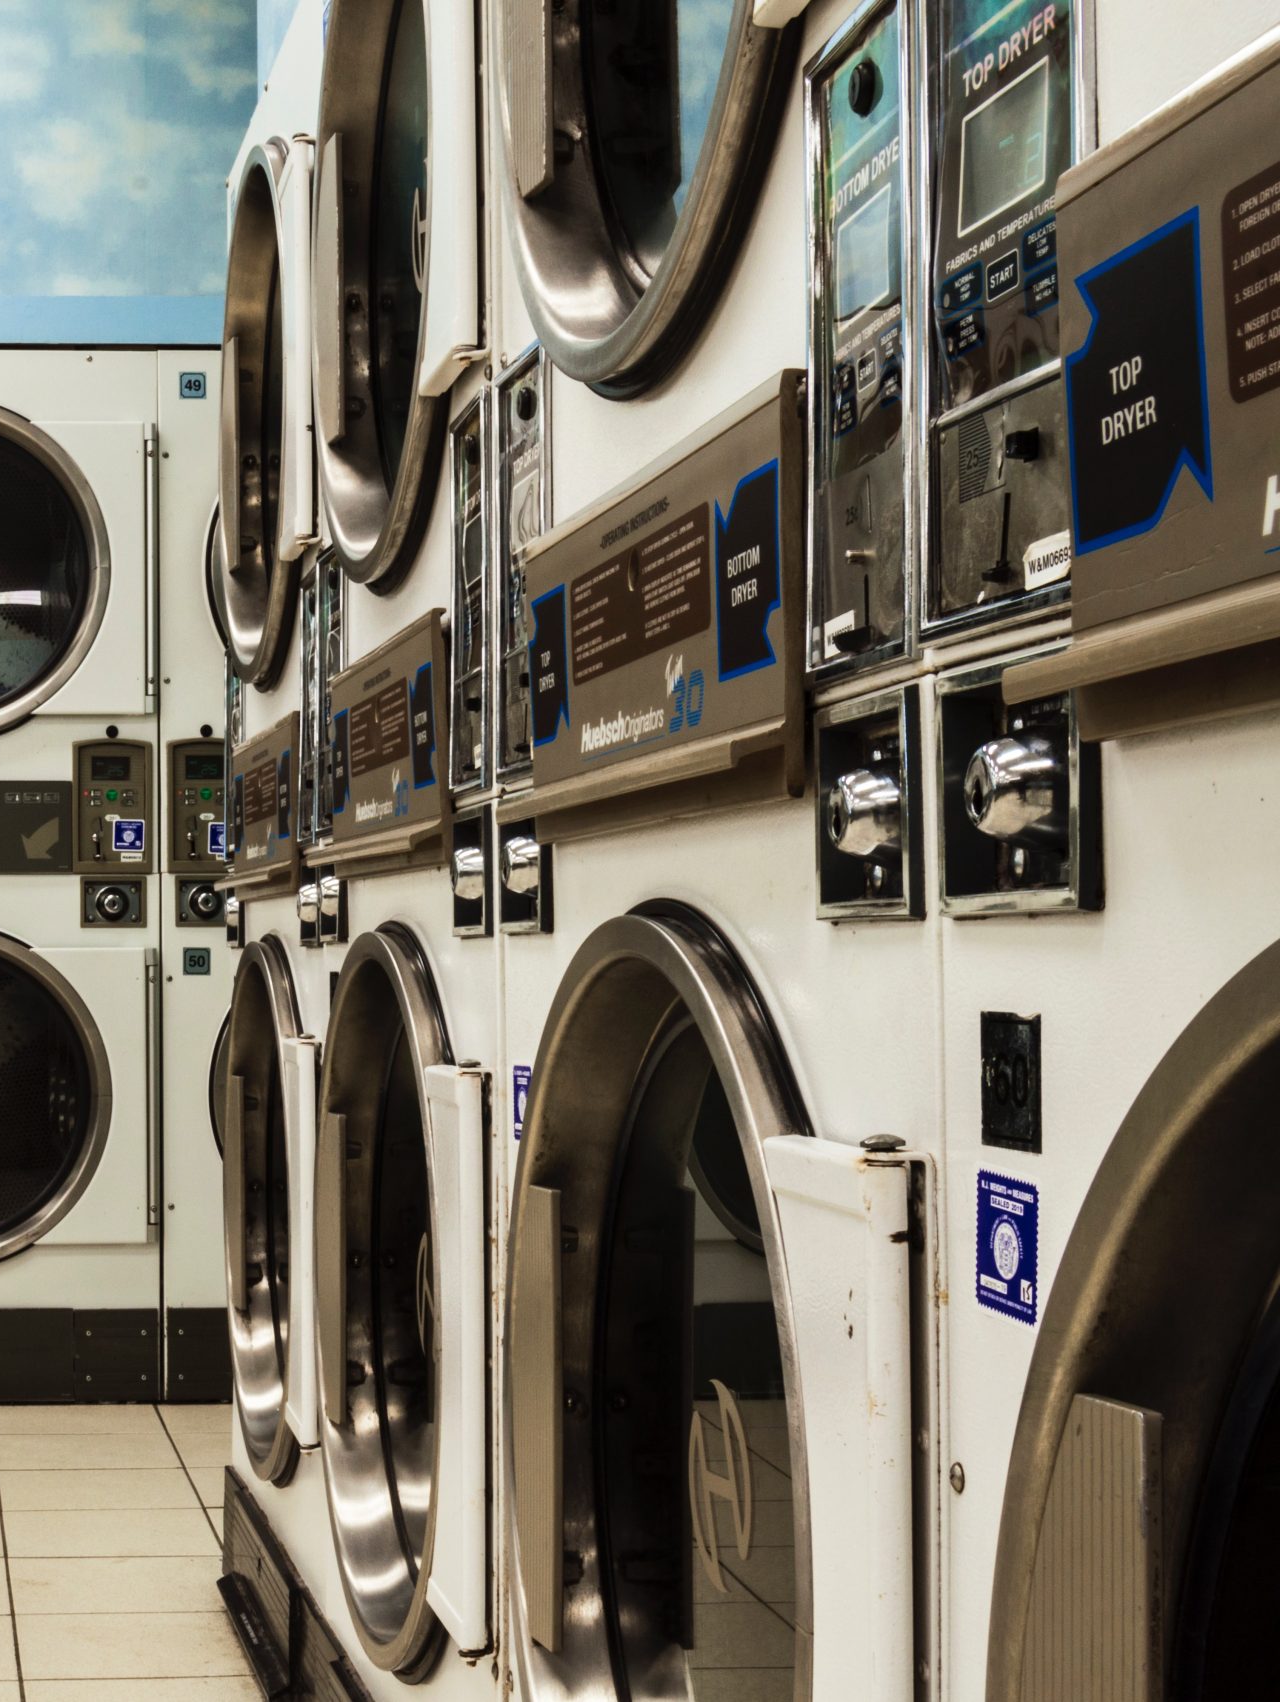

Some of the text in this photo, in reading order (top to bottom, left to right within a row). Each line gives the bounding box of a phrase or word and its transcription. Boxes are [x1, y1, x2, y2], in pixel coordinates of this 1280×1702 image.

[962, 4, 1056, 97] TOP DRYER
[871, 135, 899, 181] DRYE
[1239, 196, 1259, 215] OPEN
[1240, 205, 1270, 232] FOREIGN
[945, 195, 1056, 275] FABRICS AND TEMPERATURE
[1027, 221, 1056, 245] DELICATES
[1240, 246, 1261, 266] LOAD
[990, 264, 1014, 289] START
[1243, 278, 1268, 300] SELECT
[1244, 312, 1270, 333] INSERT
[859, 361, 874, 380] START
[1109, 355, 1142, 395] TOP
[1247, 367, 1267, 385] PUSH
[184, 379, 202, 392] 49
[1101, 396, 1157, 446] DRYER
[966, 448, 980, 470] 25
[727, 544, 760, 580] BOTTOM
[731, 578, 758, 608] DRYER
[541, 650, 550, 668] TOP
[539, 672, 555, 693] DRYER
[188, 955, 206, 968] 50
